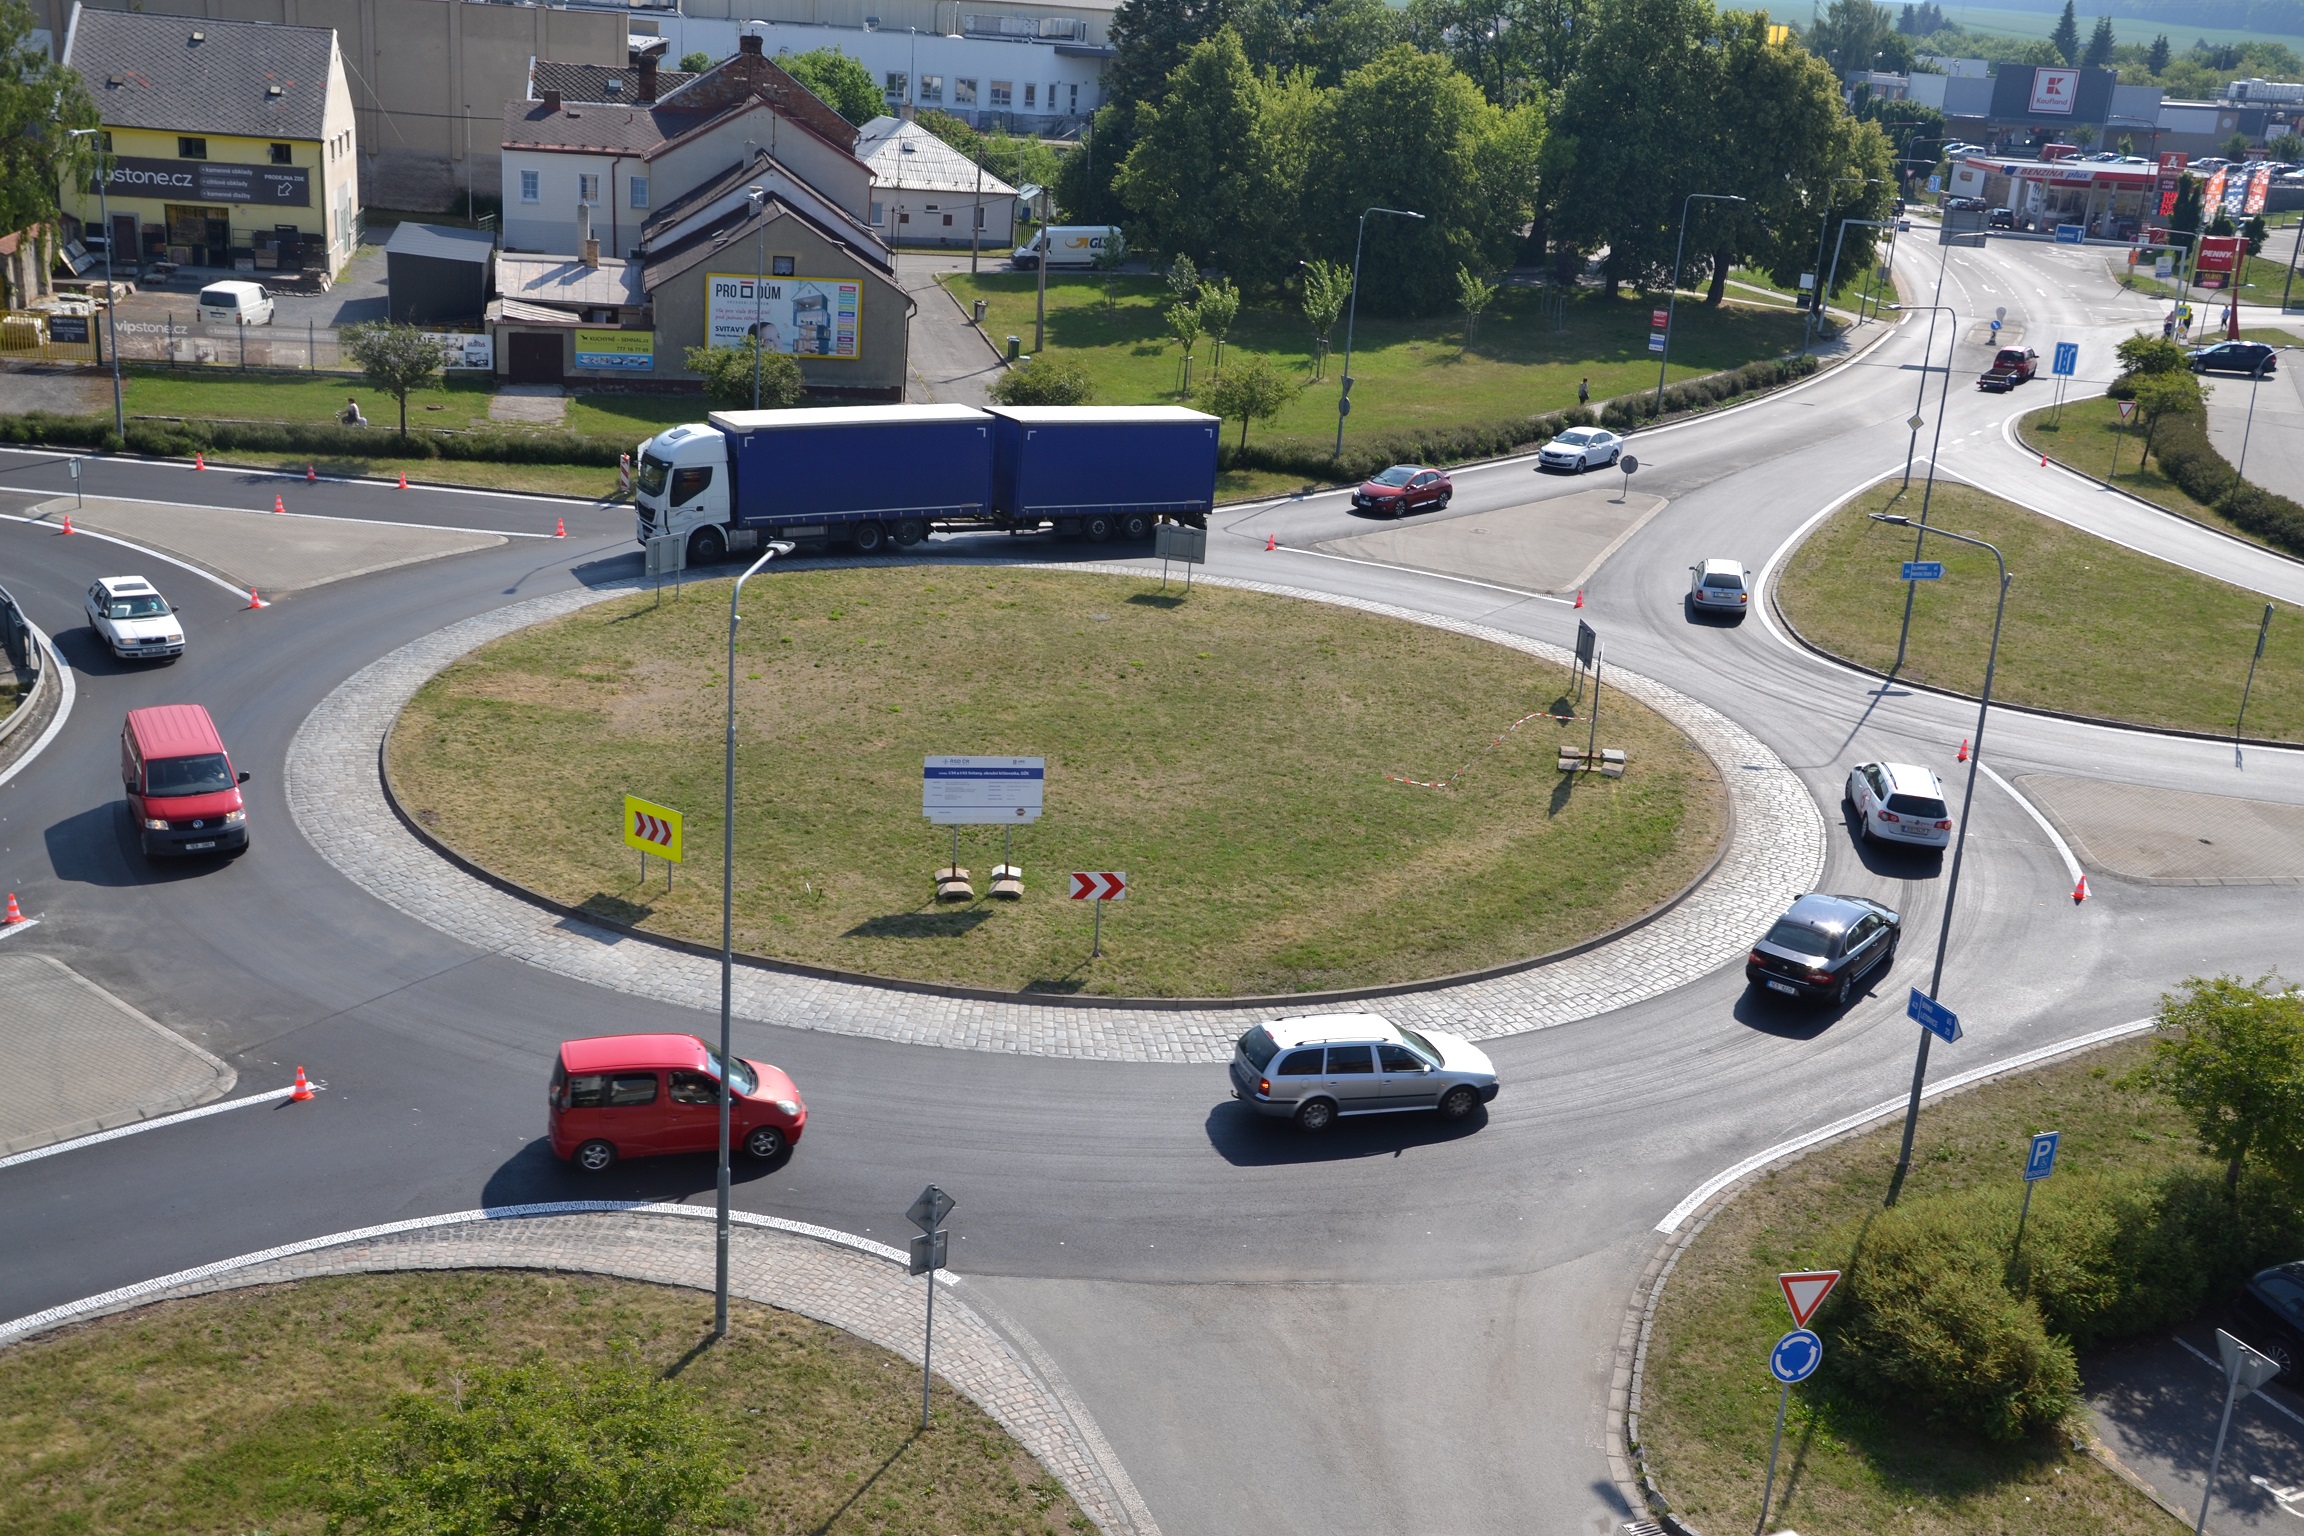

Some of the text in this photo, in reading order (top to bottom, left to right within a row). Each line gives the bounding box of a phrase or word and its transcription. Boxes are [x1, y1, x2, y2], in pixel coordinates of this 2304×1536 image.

[2036, 97, 2068, 105] Kaufland
[231, 168, 253, 176] obklady
[2020, 168, 2089, 179] BENZINA plus
[715, 282, 781, 300] PRO DŮM
[115, 320, 188, 334] vipstone.cz
[715, 325, 745, 333] SVITAVY
[1911, 1001, 1919, 1010] 43
[1921, 1001, 1952, 1026] BRNO 65
[1920, 1011, 1951, 1036] LETOVICE 25
[2032, 1140, 2052, 1167] P
